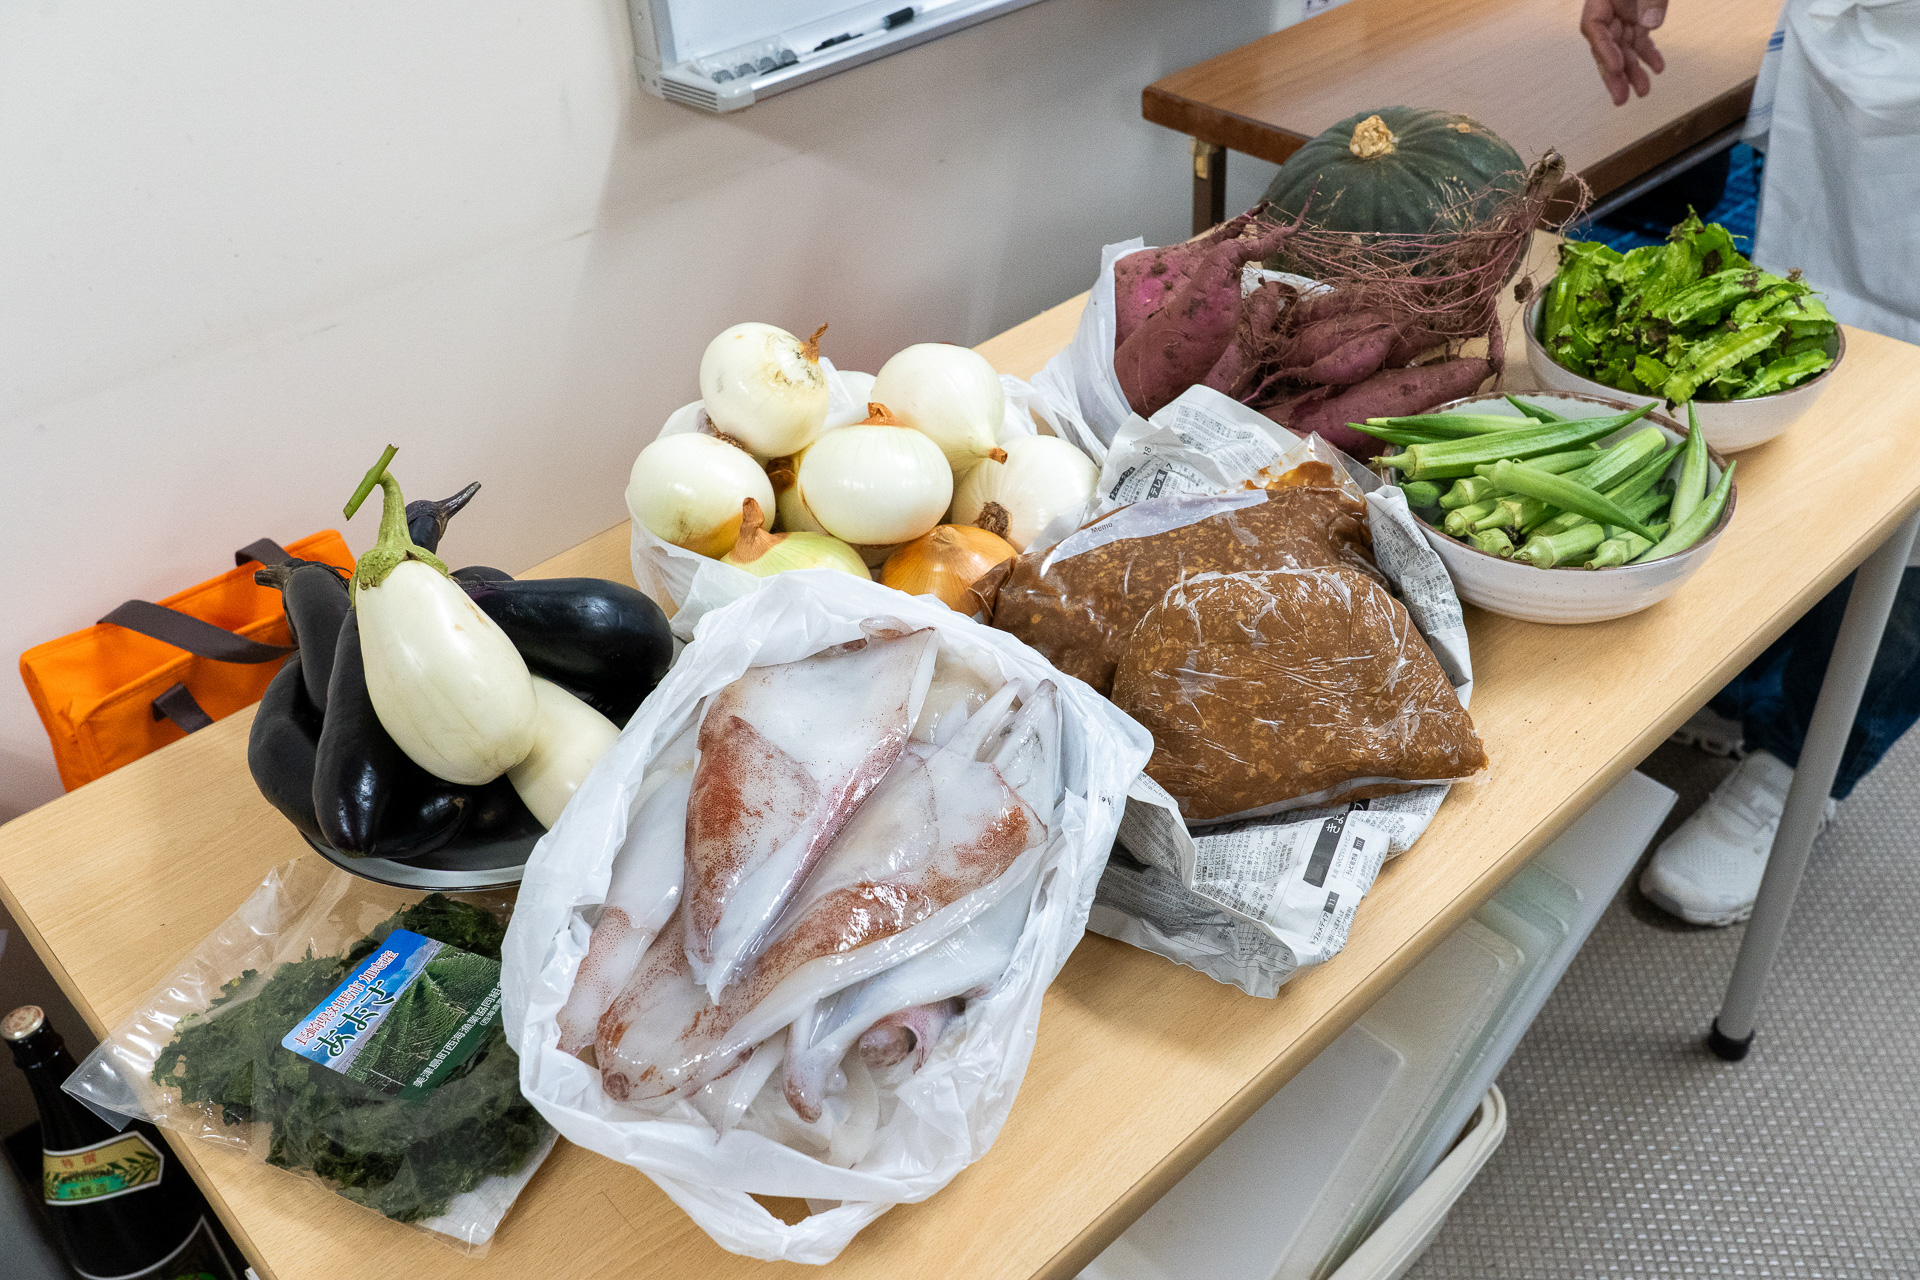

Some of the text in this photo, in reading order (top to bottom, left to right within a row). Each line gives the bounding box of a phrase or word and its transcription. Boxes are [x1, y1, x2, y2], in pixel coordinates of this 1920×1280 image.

[1091, 522, 1112, 533] Memo
[294, 979, 365, 1046] 長崎県対馬市
[312, 979, 396, 1058] あおさ
